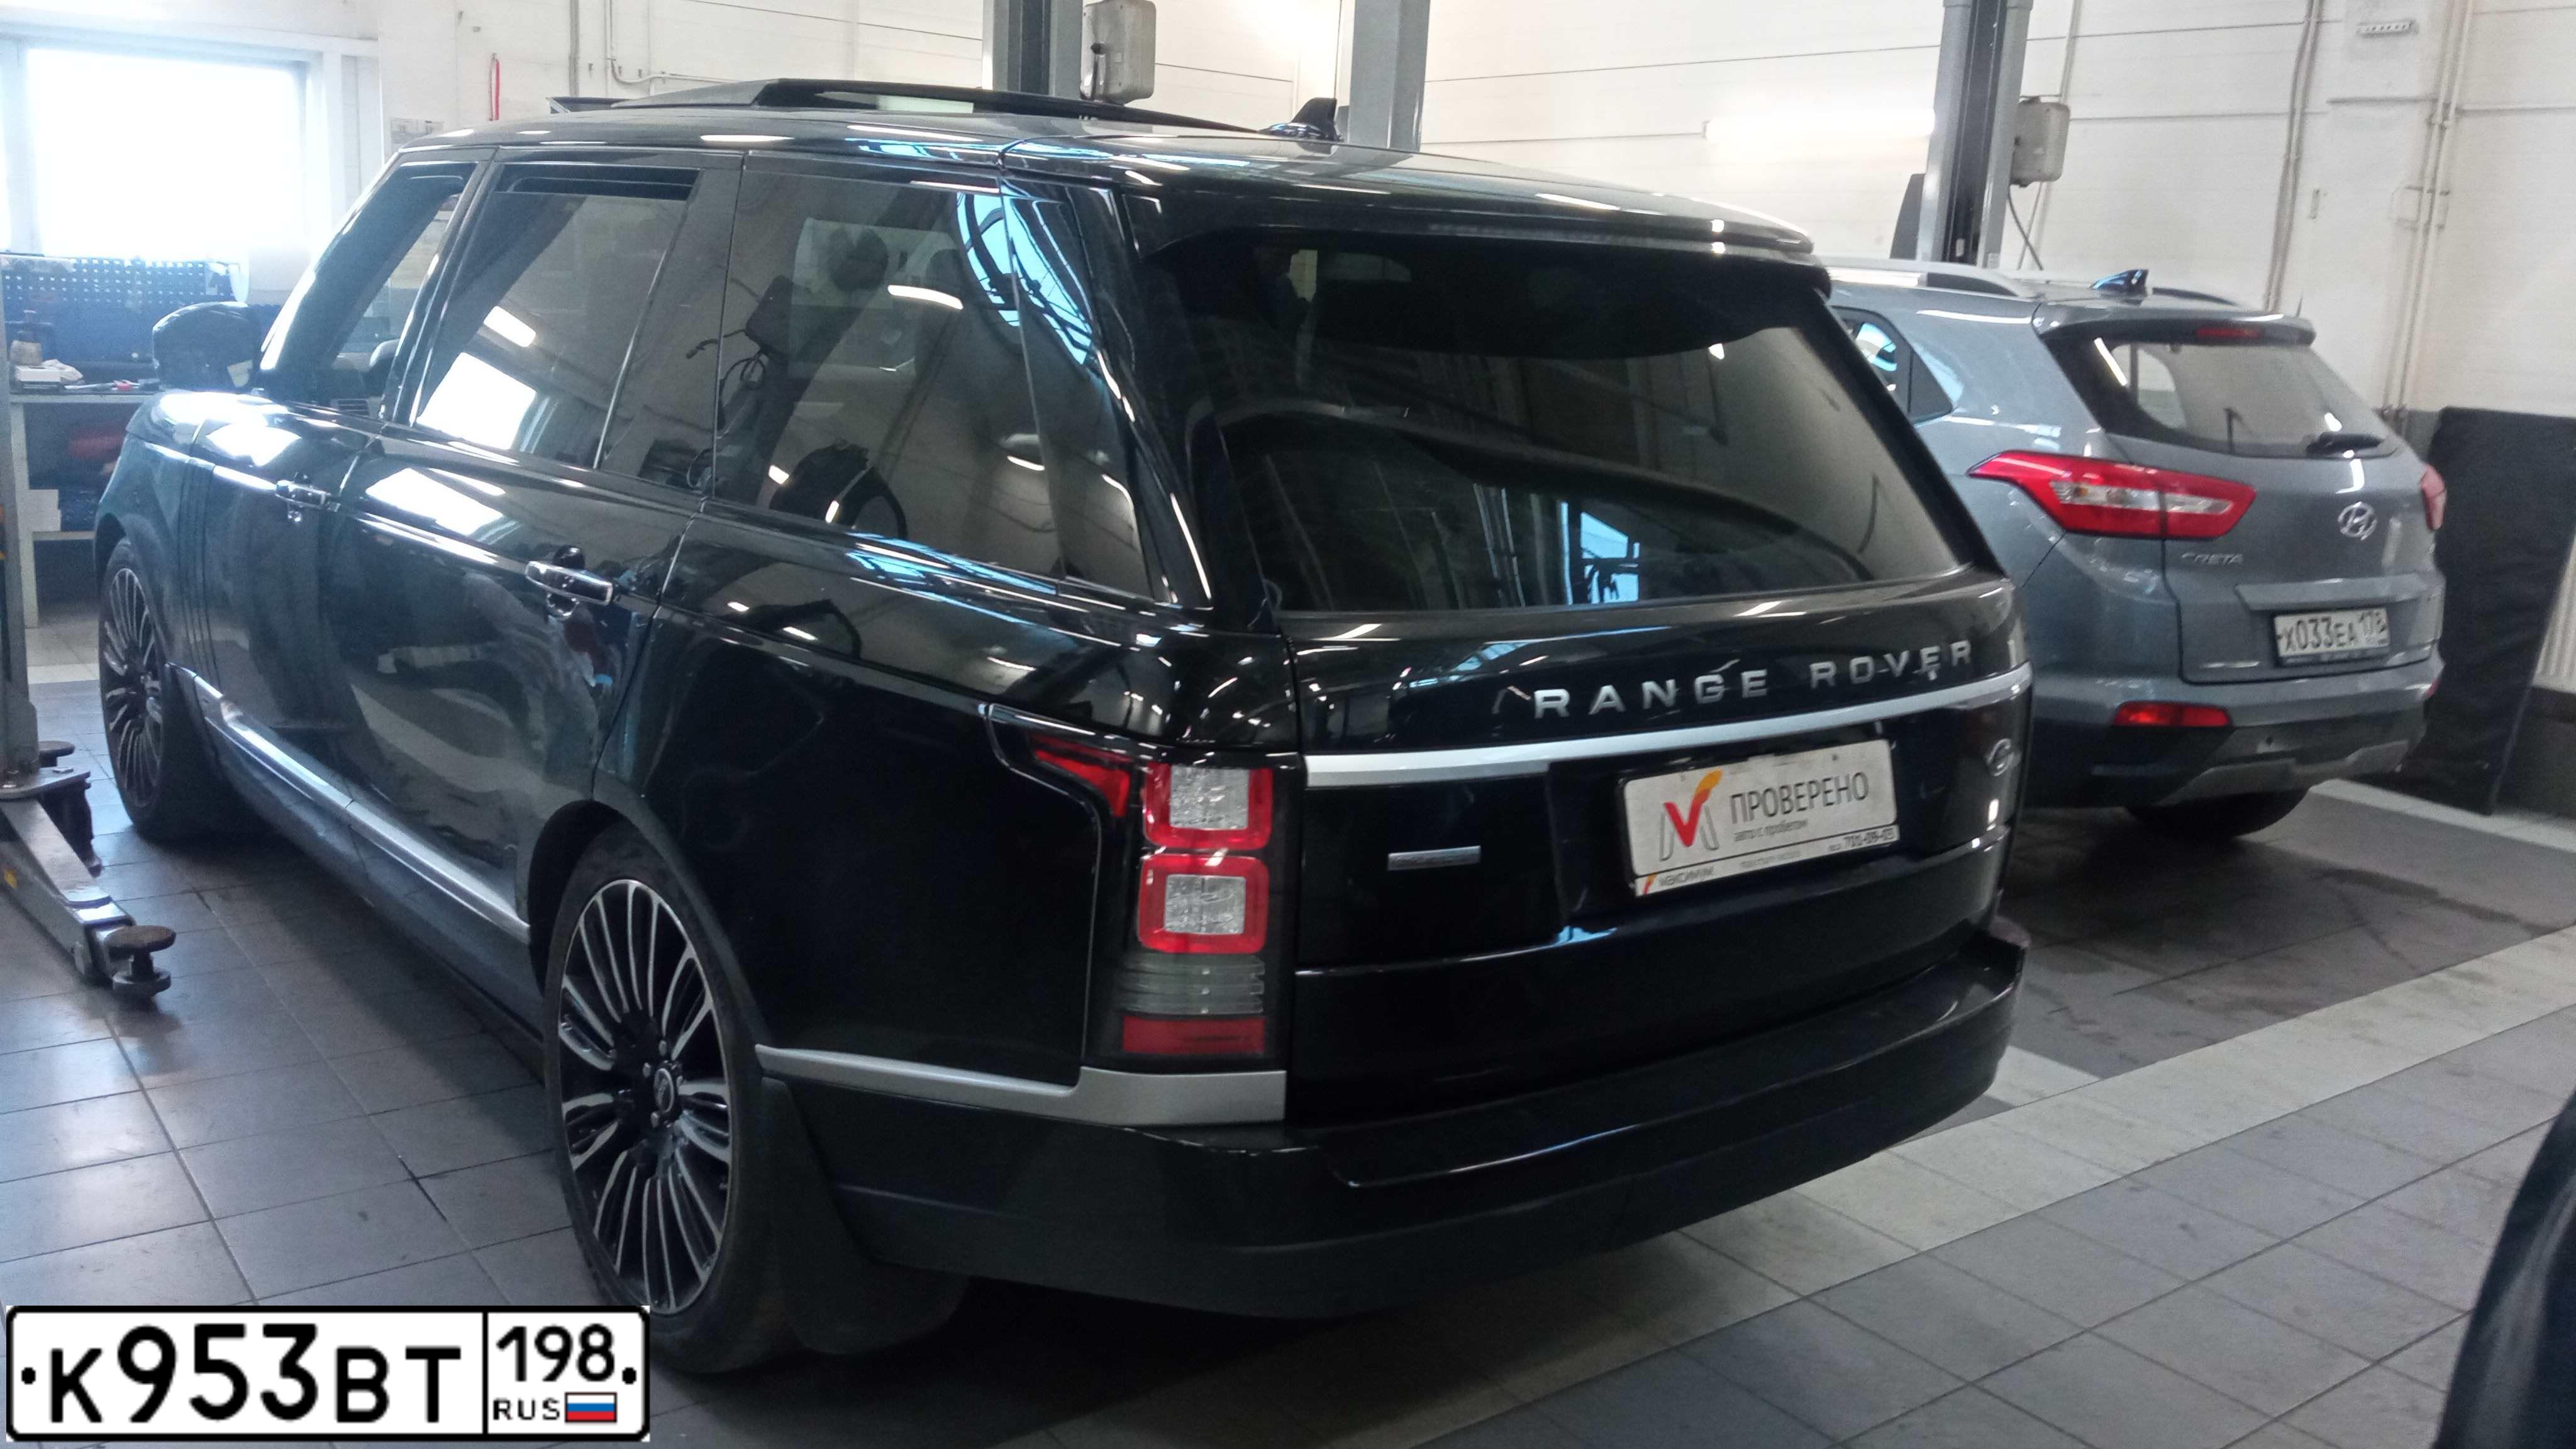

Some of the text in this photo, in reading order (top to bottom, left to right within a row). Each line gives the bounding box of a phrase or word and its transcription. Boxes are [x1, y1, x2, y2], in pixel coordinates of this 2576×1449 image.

[1534, 640, 1972, 719] RANGE ROVER
[1730, 771, 1870, 824] ПРОВЕРЕНО
